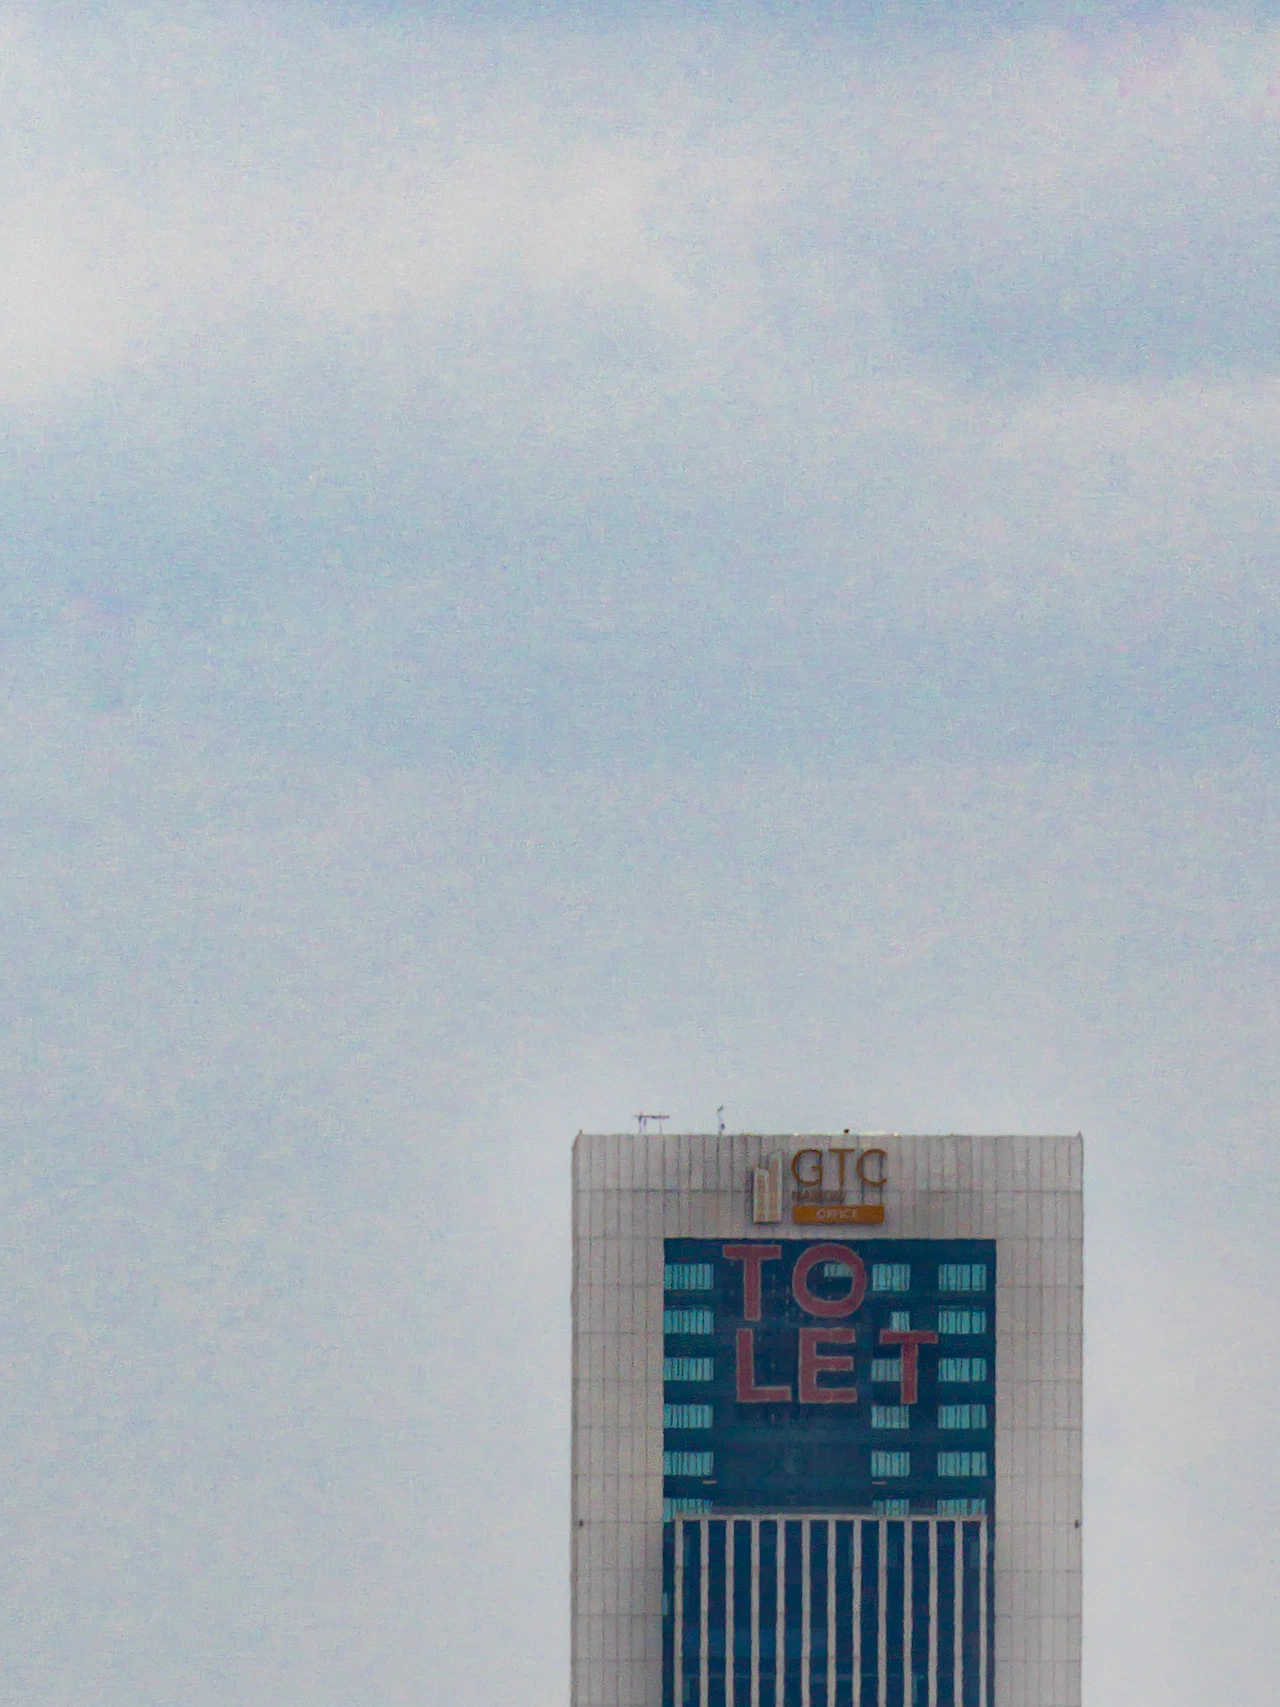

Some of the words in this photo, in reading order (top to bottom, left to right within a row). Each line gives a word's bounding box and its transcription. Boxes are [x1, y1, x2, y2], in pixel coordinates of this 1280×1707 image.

[791, 1148, 887, 1186] GTC
[722, 1242, 867, 1321] TO
[735, 1327, 938, 1404] LET
